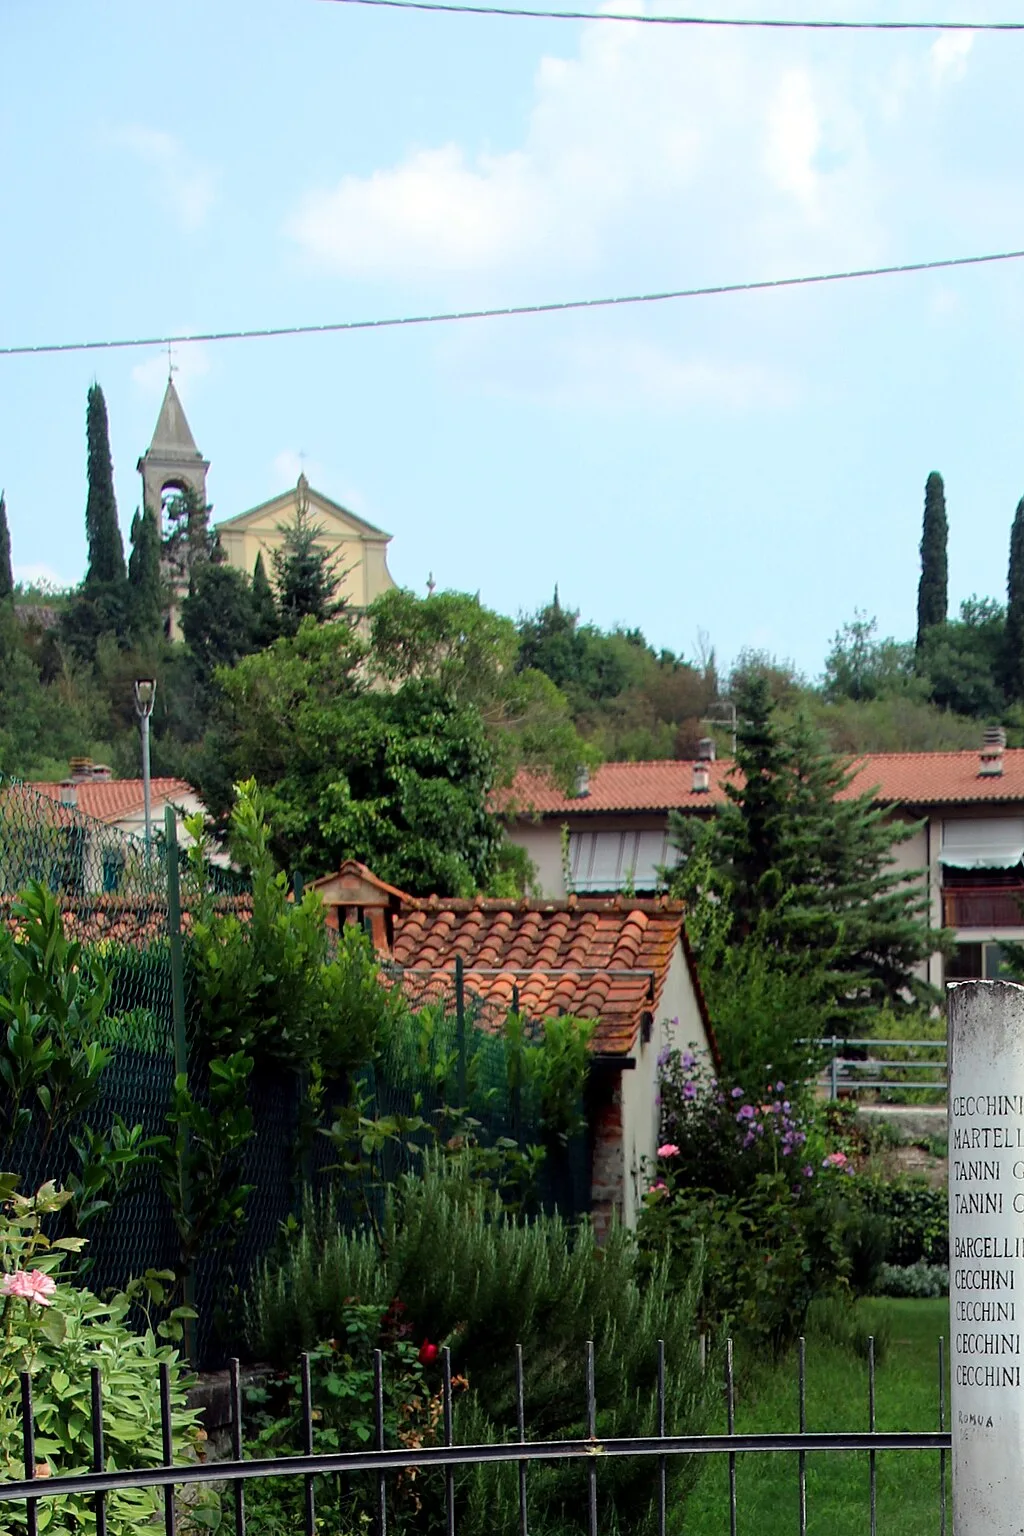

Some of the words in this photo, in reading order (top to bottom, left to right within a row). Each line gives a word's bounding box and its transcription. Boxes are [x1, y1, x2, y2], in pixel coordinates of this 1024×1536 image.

[952, 1095, 1024, 1117] CECCHINI
[954, 1161, 1000, 1181] TANINI
[954, 1192, 1003, 1214] TANINI
[954, 1269, 1015, 1290] CECCHINI
[955, 1301, 1016, 1322] CECCHINI
[956, 1333, 1020, 1355] CECCHINI
[956, 1365, 1020, 1387] CECCHINI
